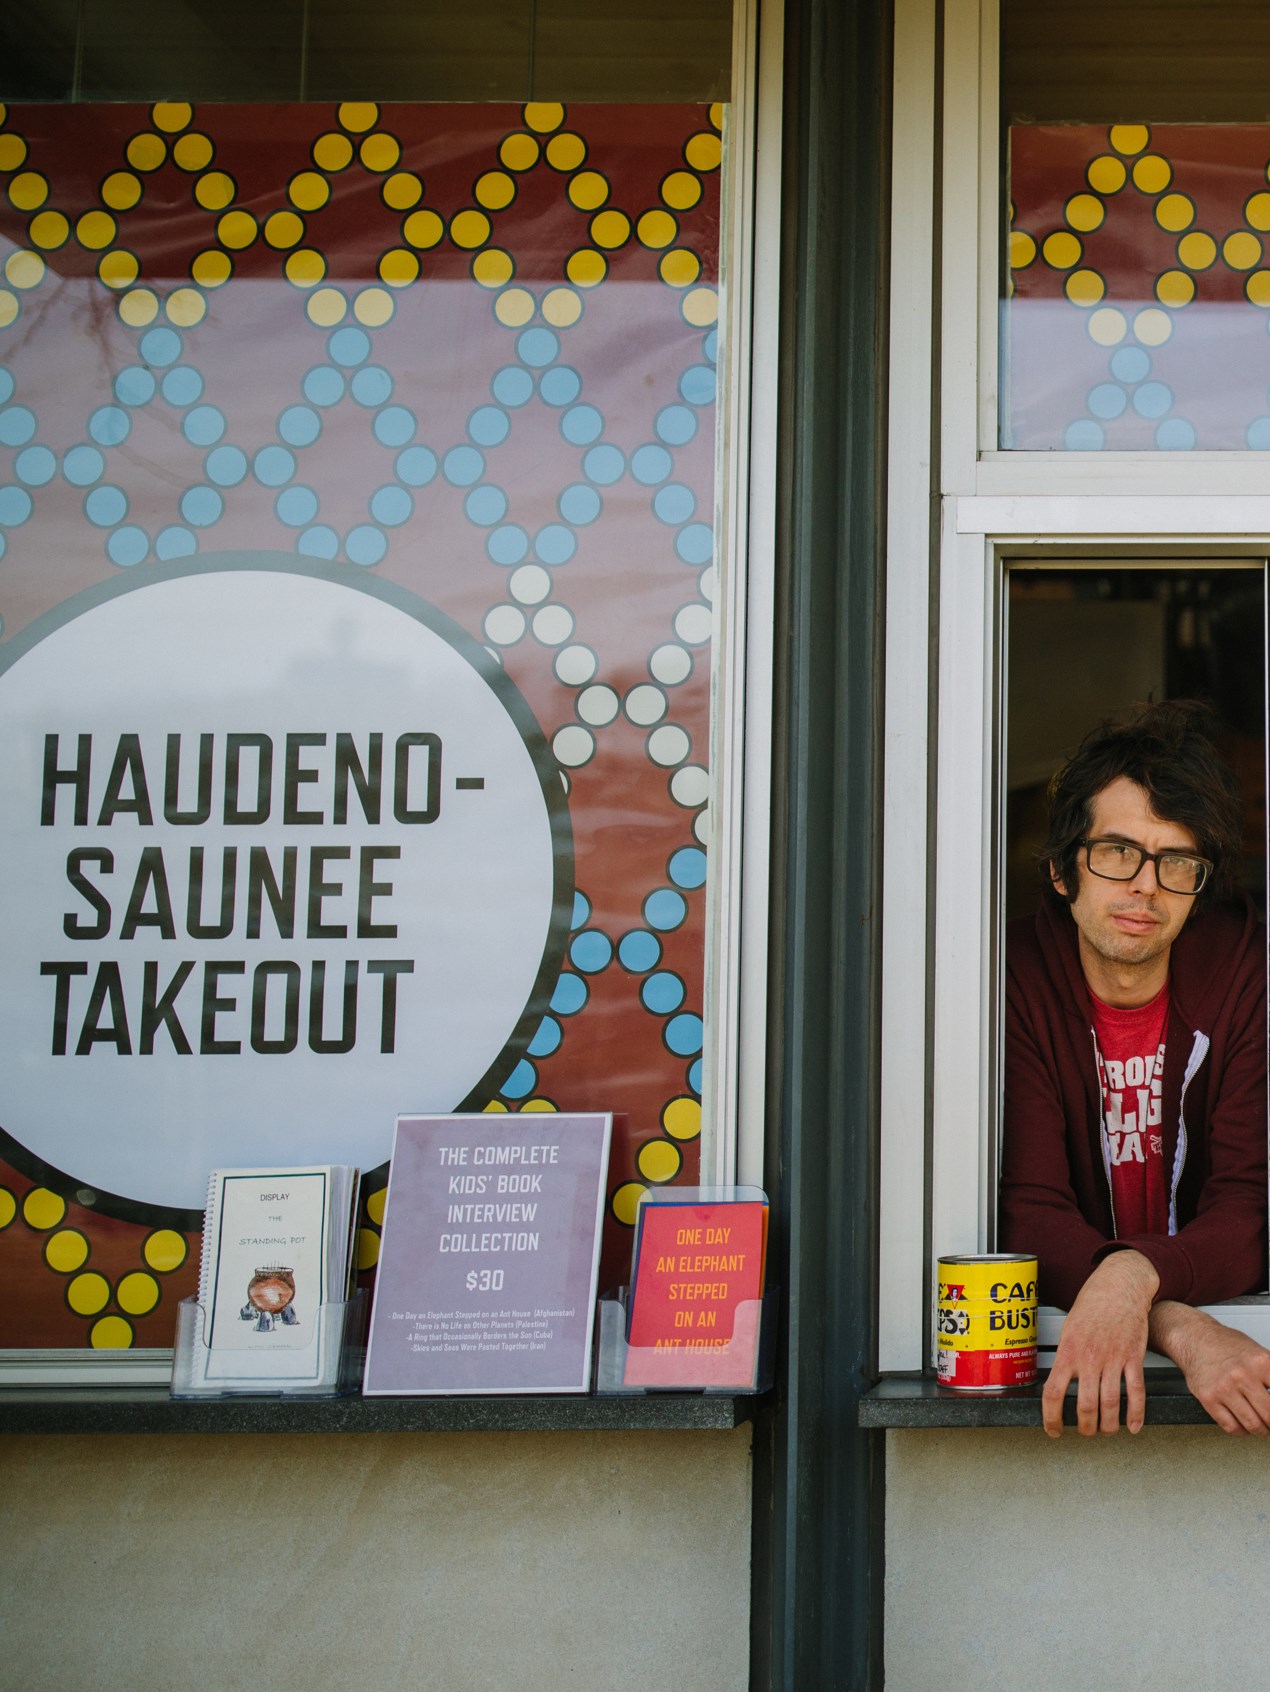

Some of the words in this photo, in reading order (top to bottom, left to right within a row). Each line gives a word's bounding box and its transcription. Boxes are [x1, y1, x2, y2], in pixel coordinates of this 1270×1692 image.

[40, 732, 485, 826] HAUDENO-
[63, 845, 401, 940] SAUNEE
[39, 959, 415, 1056] TAKEOUT
[439, 1147, 469, 1165] THE
[474, 1146, 559, 1165] COMPLETE
[449, 1176, 492, 1194] KIDS'
[497, 1175, 542, 1193] BOOK
[260, 1193, 290, 1201] DISPLAY
[448, 1203, 537, 1223] INTERVIEW
[238, 1237, 287, 1246] STANDING
[290, 1236, 306, 1244] POT
[440, 1233, 539, 1252] COLLECTION
[676, 1229, 702, 1245] ONE
[706, 1228, 731, 1244] DAY
[656, 1256, 676, 1273] AN
[679, 1255, 746, 1272] ELEPHANT
[466, 1270, 504, 1291] $30
[668, 1283, 728, 1300] STEPPED
[674, 1311, 694, 1328] ON
[697, 1311, 717, 1327] AN
[653, 1338, 683, 1356] ANT
[684, 1338, 731, 1355] HOUSE
